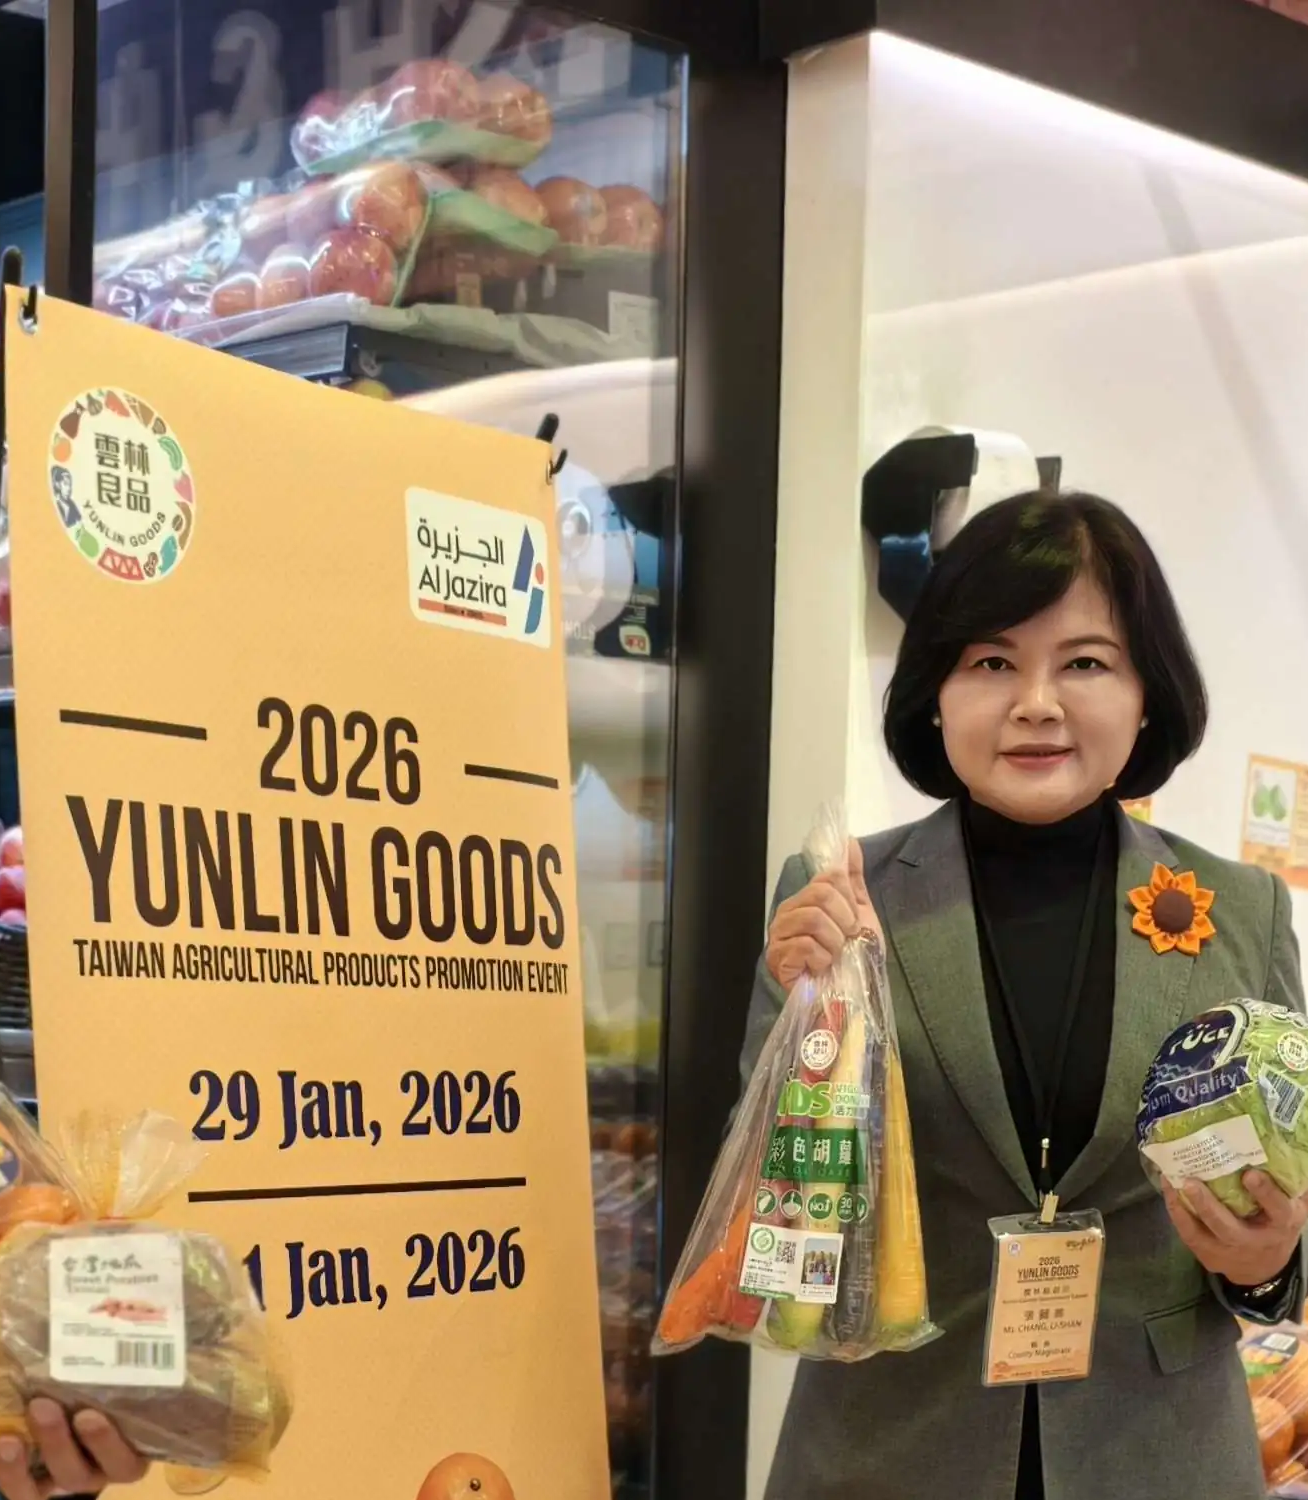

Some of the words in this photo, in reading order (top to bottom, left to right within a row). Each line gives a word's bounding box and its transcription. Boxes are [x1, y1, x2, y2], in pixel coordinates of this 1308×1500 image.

[94, 432, 151, 477] 雲林
[96, 471, 152, 514] 良品
[82, 500, 126, 546] YUNLIN
[129, 510, 167, 548] GOODS
[416, 517, 505, 569] الجزيرة
[257, 696, 421, 806] 2026
[65, 795, 351, 937] YUNLIN
[371, 826, 565, 949] GOODS
[73, 939, 166, 979] TAIWAN
[172, 943, 319, 985] AGRICULTURAL
[324, 951, 421, 989] PRODUCTS
[426, 956, 523, 992] PROMOTION
[527, 960, 569, 995] EVENT
[189, 1069, 261, 1141] 29
[277, 1070, 382, 1150] Jan,
[400, 1069, 522, 1137] 2026
[1174, 1070, 1239, 1104] Quality
[242, 1244, 267, 1312] 1
[285, 1241, 388, 1320] Jan,
[406, 1226, 526, 1299] 2026
[1017, 1267, 1049, 1279] YUNLIN
[1051, 1265, 1080, 1277] GOODS
